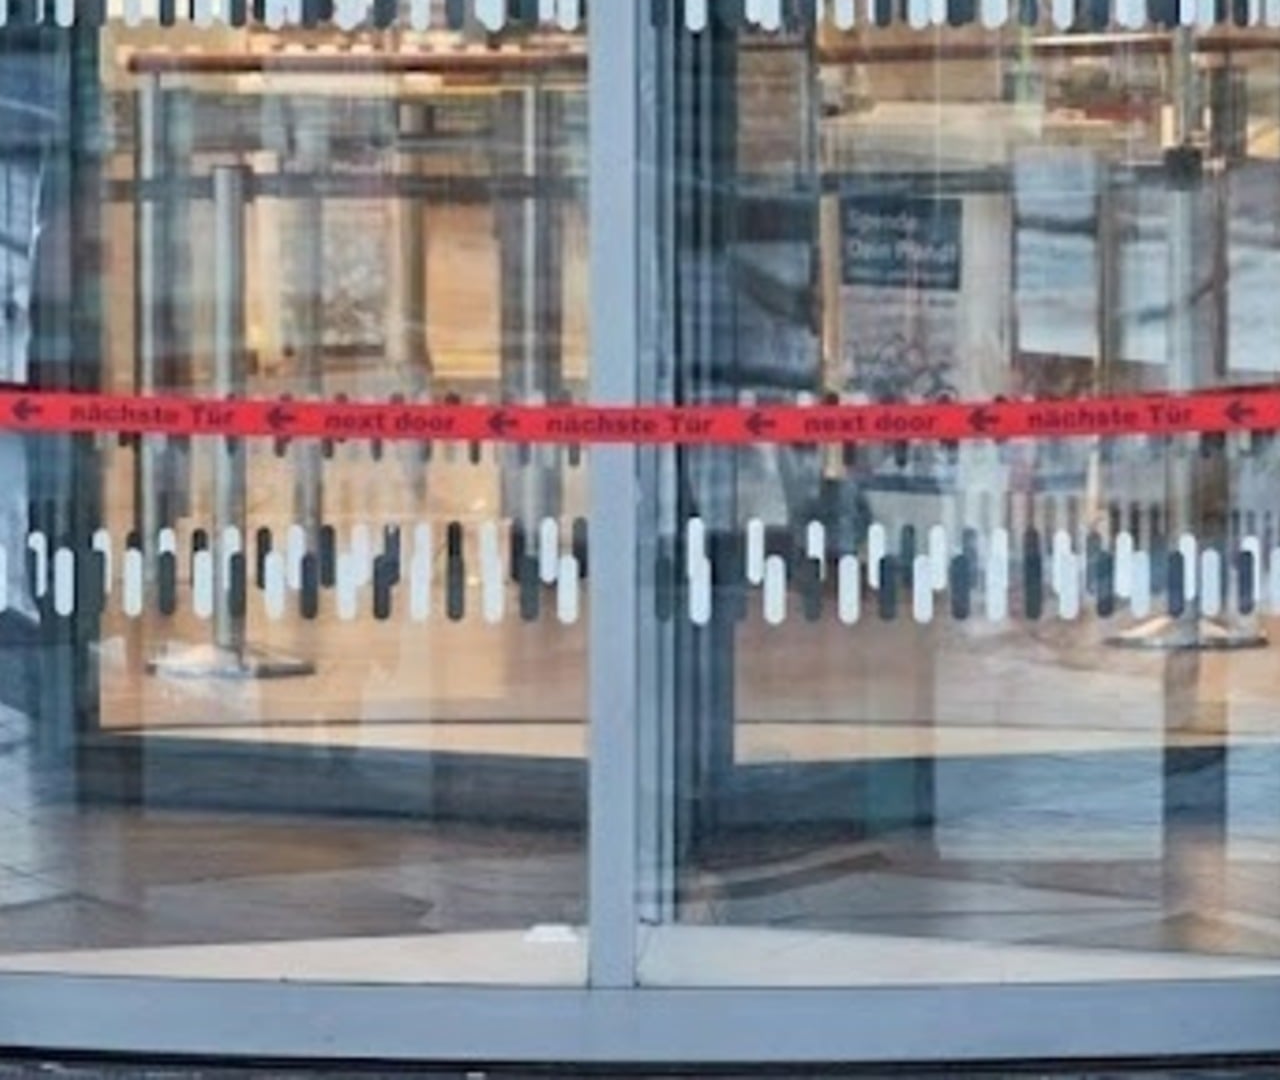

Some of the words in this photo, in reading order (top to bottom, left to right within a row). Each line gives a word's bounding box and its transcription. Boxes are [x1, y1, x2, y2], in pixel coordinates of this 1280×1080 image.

[323, 411, 388, 432] next
[394, 410, 456, 432] door
[803, 411, 866, 434] next
[874, 408, 939, 433] door
